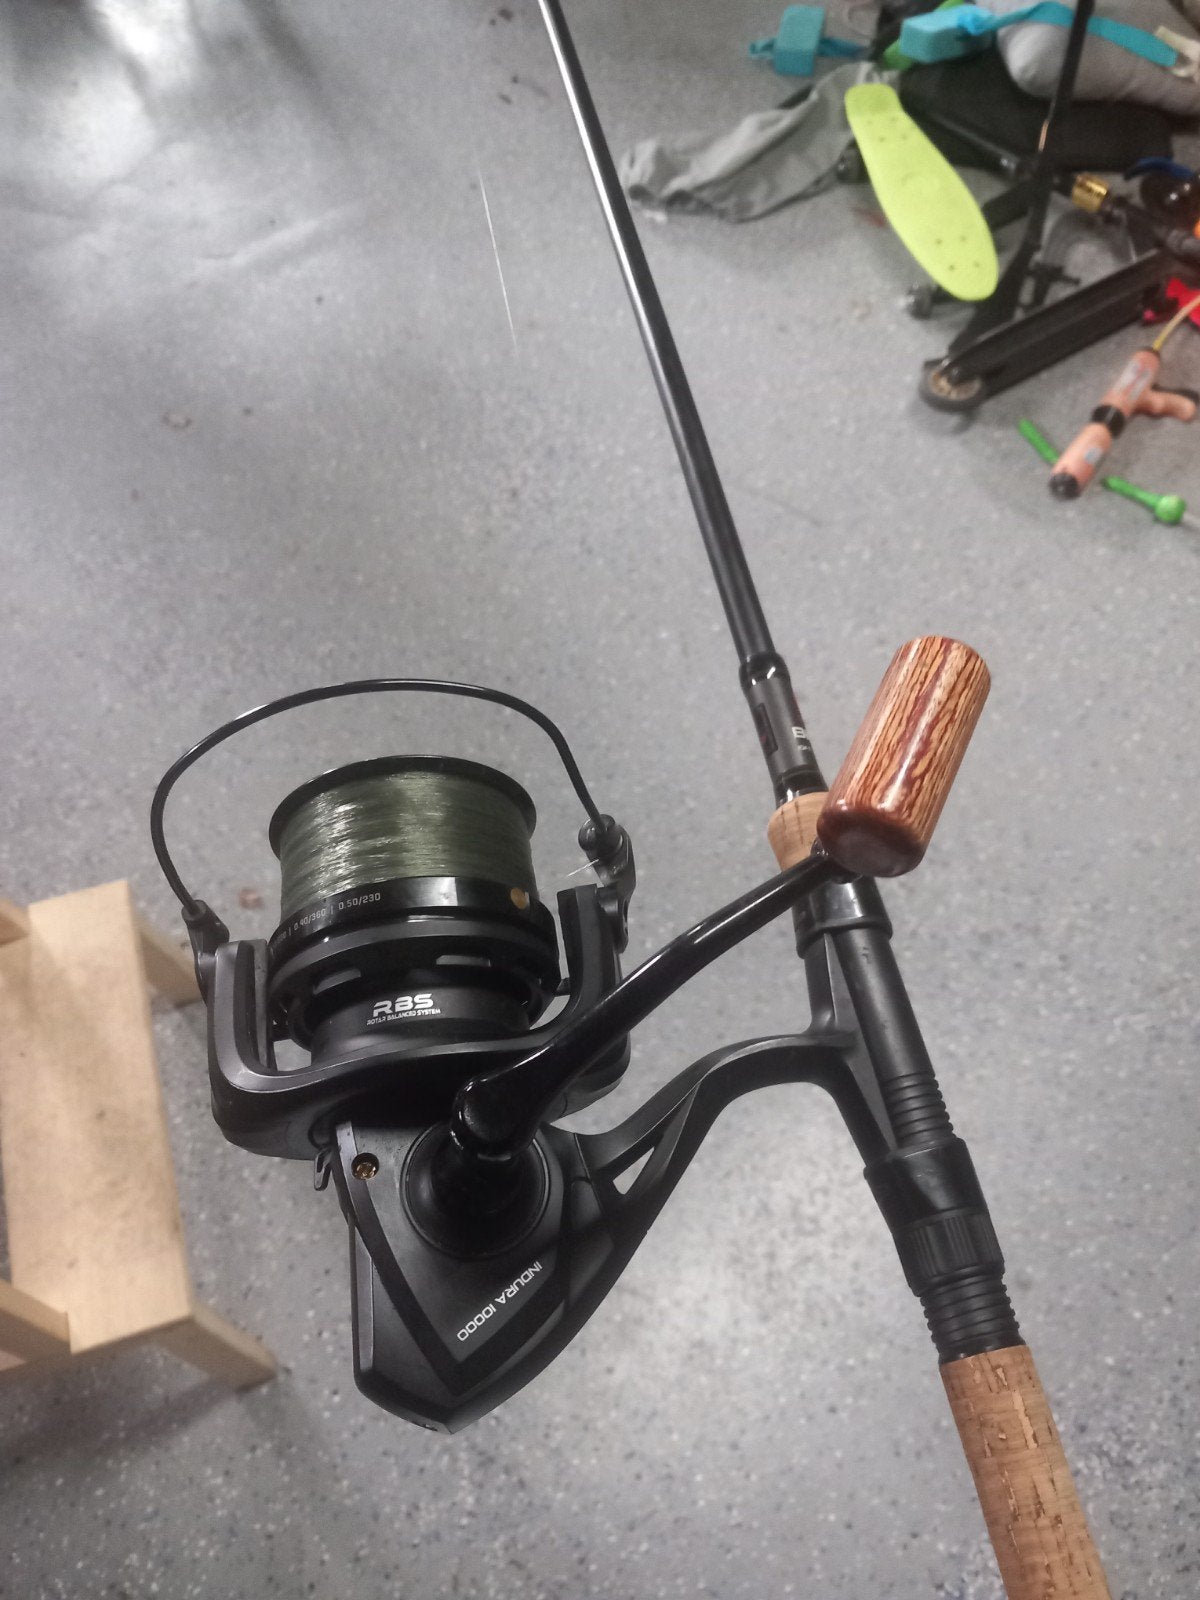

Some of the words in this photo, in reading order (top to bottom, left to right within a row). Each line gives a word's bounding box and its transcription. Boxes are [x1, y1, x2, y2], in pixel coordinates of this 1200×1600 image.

[338, 892, 381, 910] 0.50/230
[373, 993, 434, 1017] RBS
[387, 1010, 416, 1021] BALANCED
[416, 1008, 441, 1016] SYSTEM
[495, 1261, 542, 1304] INDURA
[457, 1303, 496, 1341] 10000
